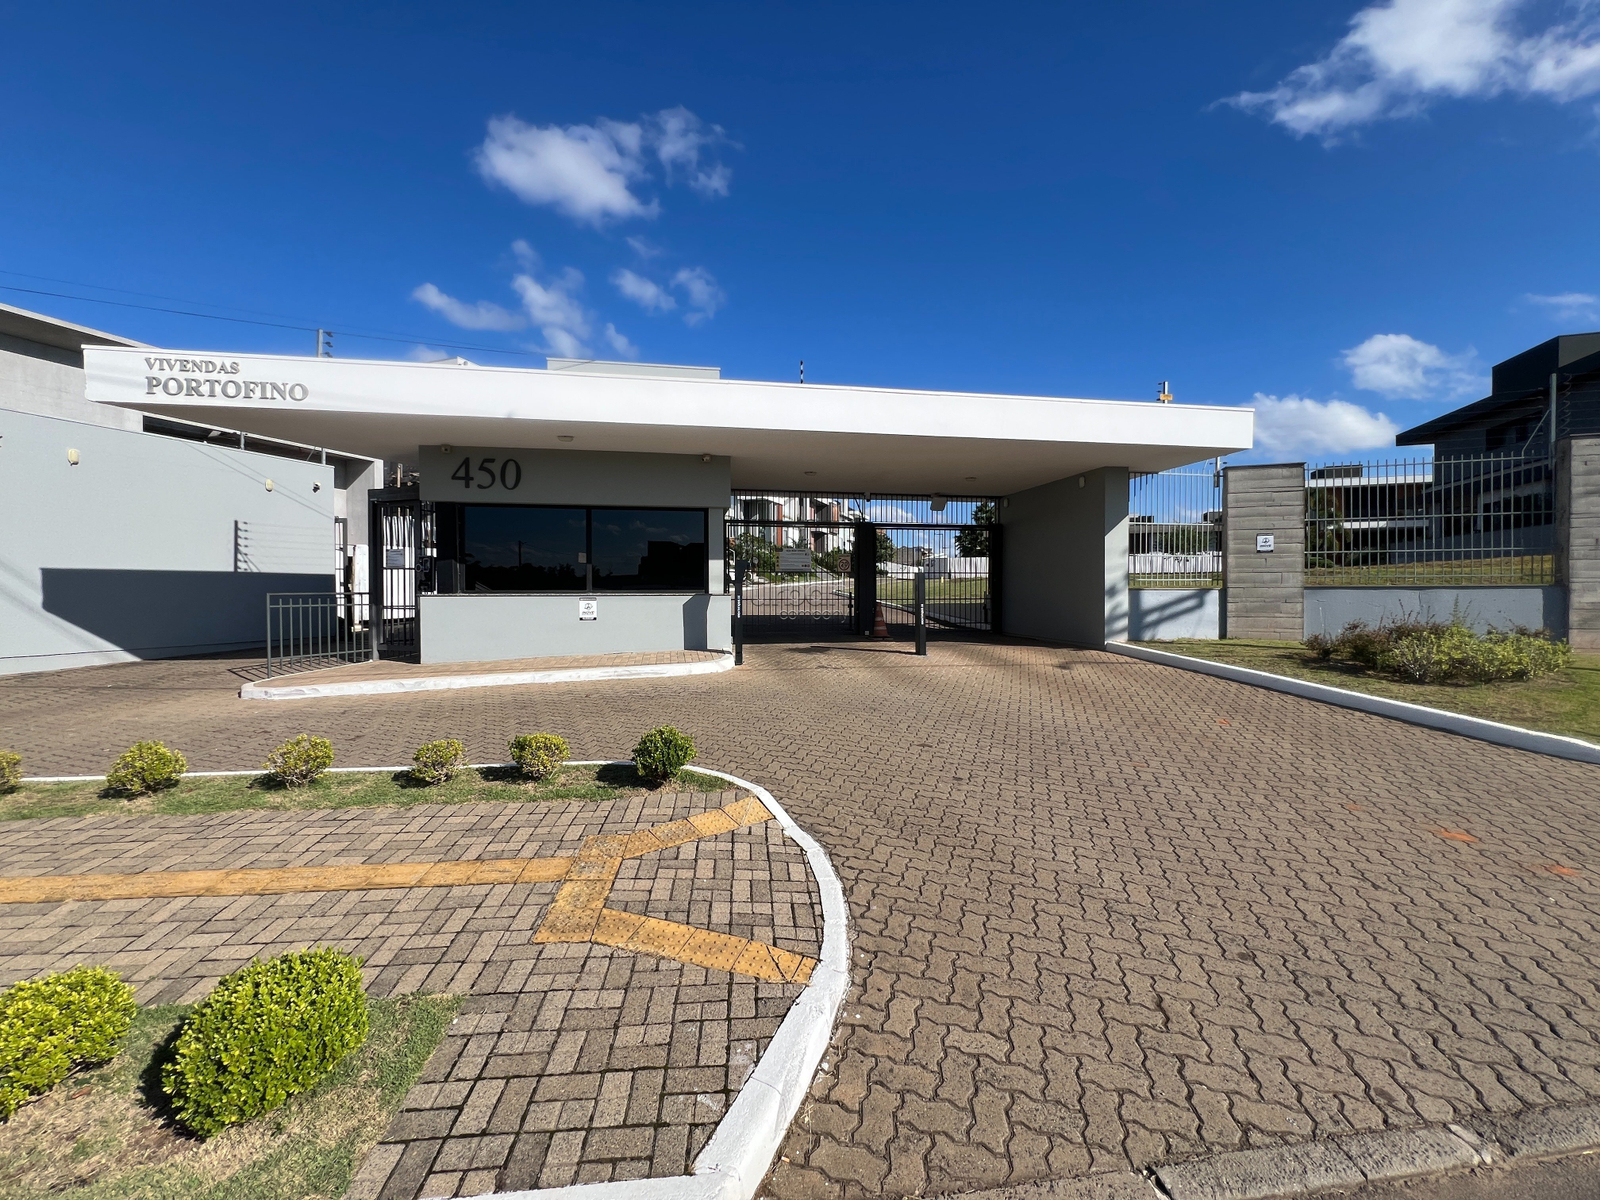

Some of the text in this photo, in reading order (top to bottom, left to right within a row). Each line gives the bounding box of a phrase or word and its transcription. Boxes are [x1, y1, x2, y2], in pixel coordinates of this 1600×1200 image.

[145, 357, 240, 374] VIVENDAS
[145, 376, 309, 401] PORTOFINO
[451, 457, 521, 490] 450
